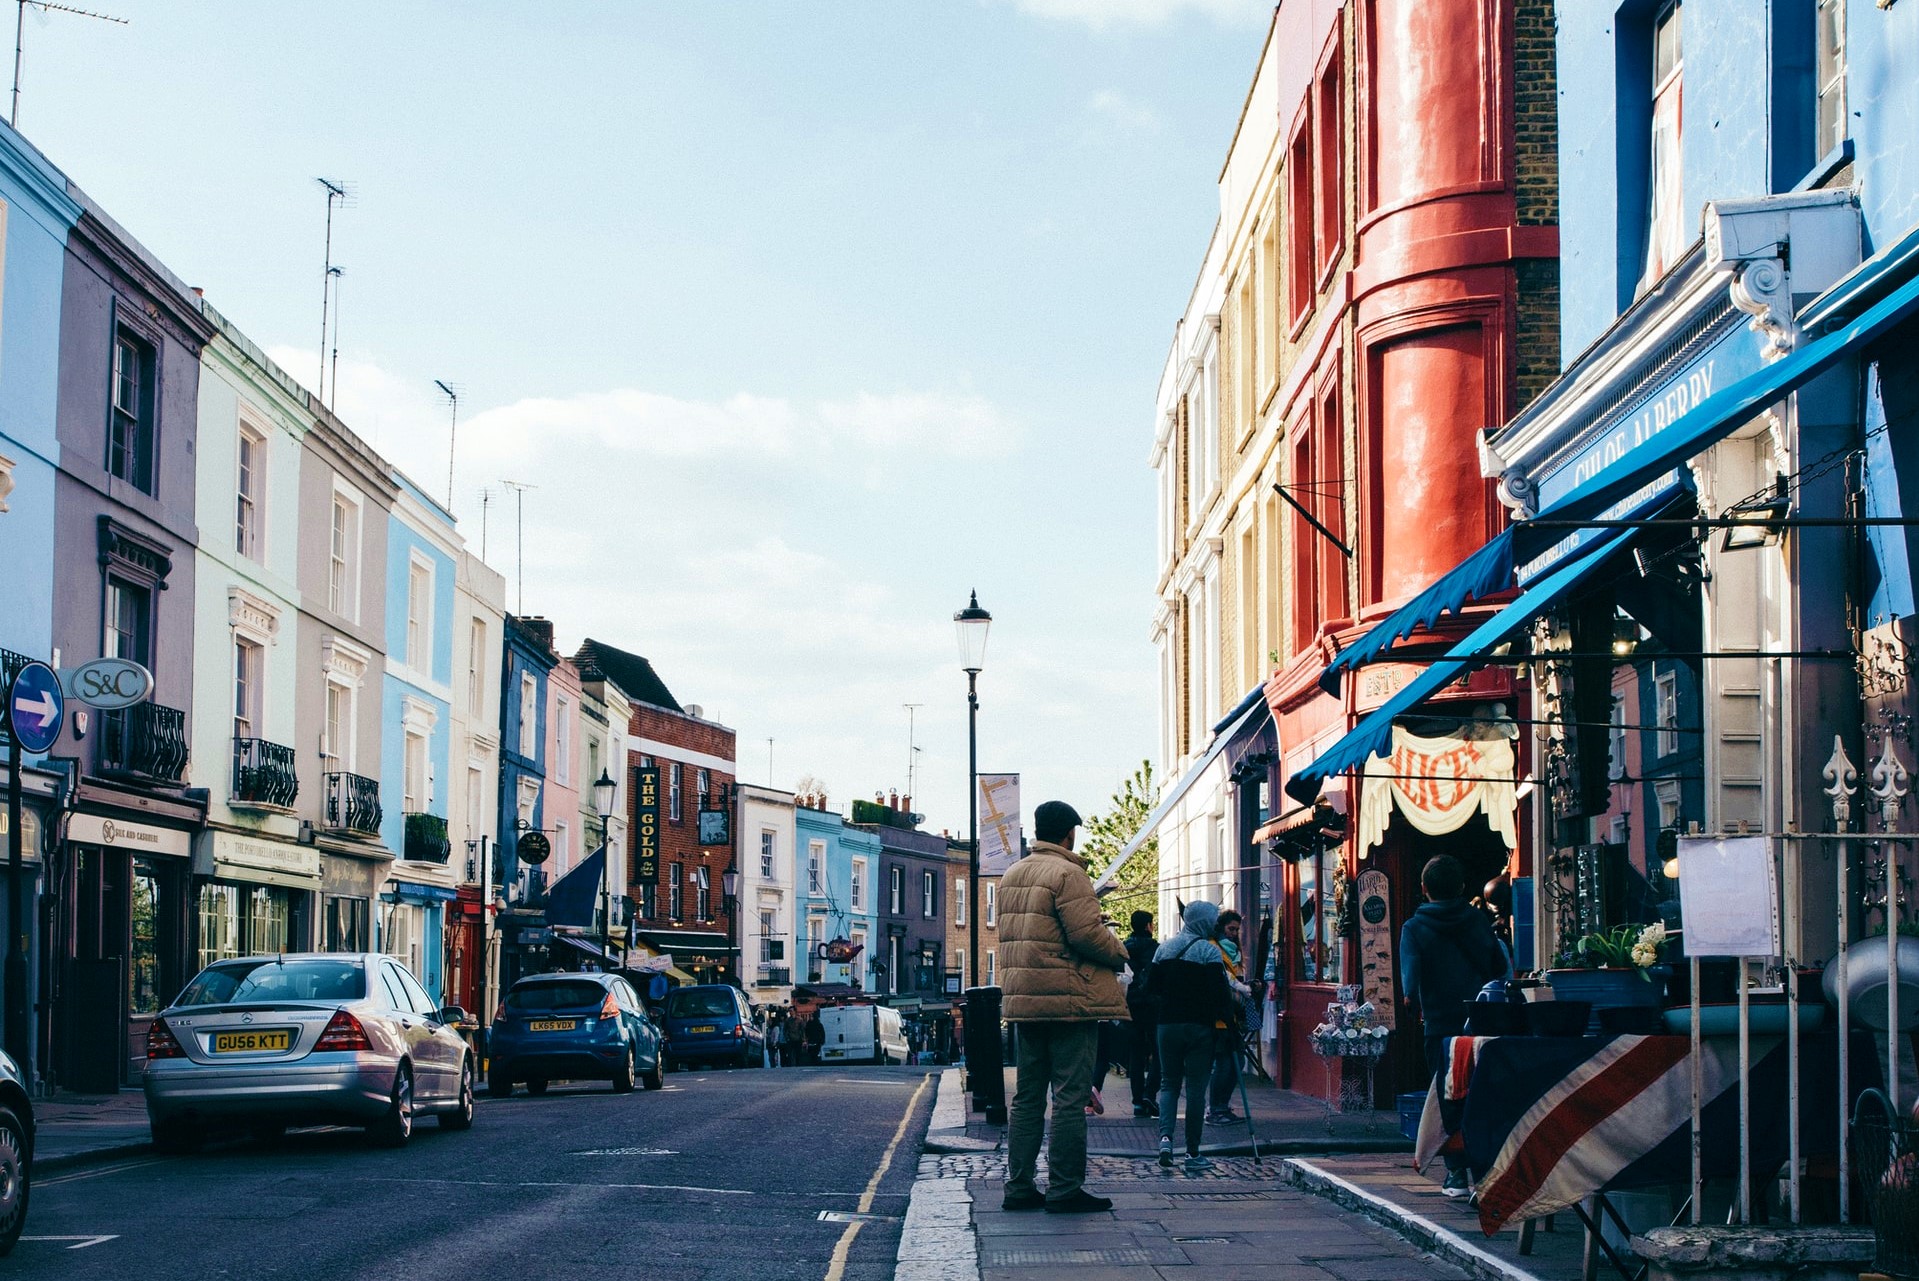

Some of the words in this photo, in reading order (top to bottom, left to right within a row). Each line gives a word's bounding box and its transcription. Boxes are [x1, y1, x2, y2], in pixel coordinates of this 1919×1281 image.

[1634, 361, 1714, 447] ALBERRY
[83, 670, 138, 698] S&C
[642, 774, 655, 806] THE
[641, 813, 654, 857] GOLD
[533, 1021, 554, 1030] LK65
[557, 1021, 573, 1029] VDX
[218, 1036, 256, 1050] GU56
[259, 1034, 287, 1048] KTT
